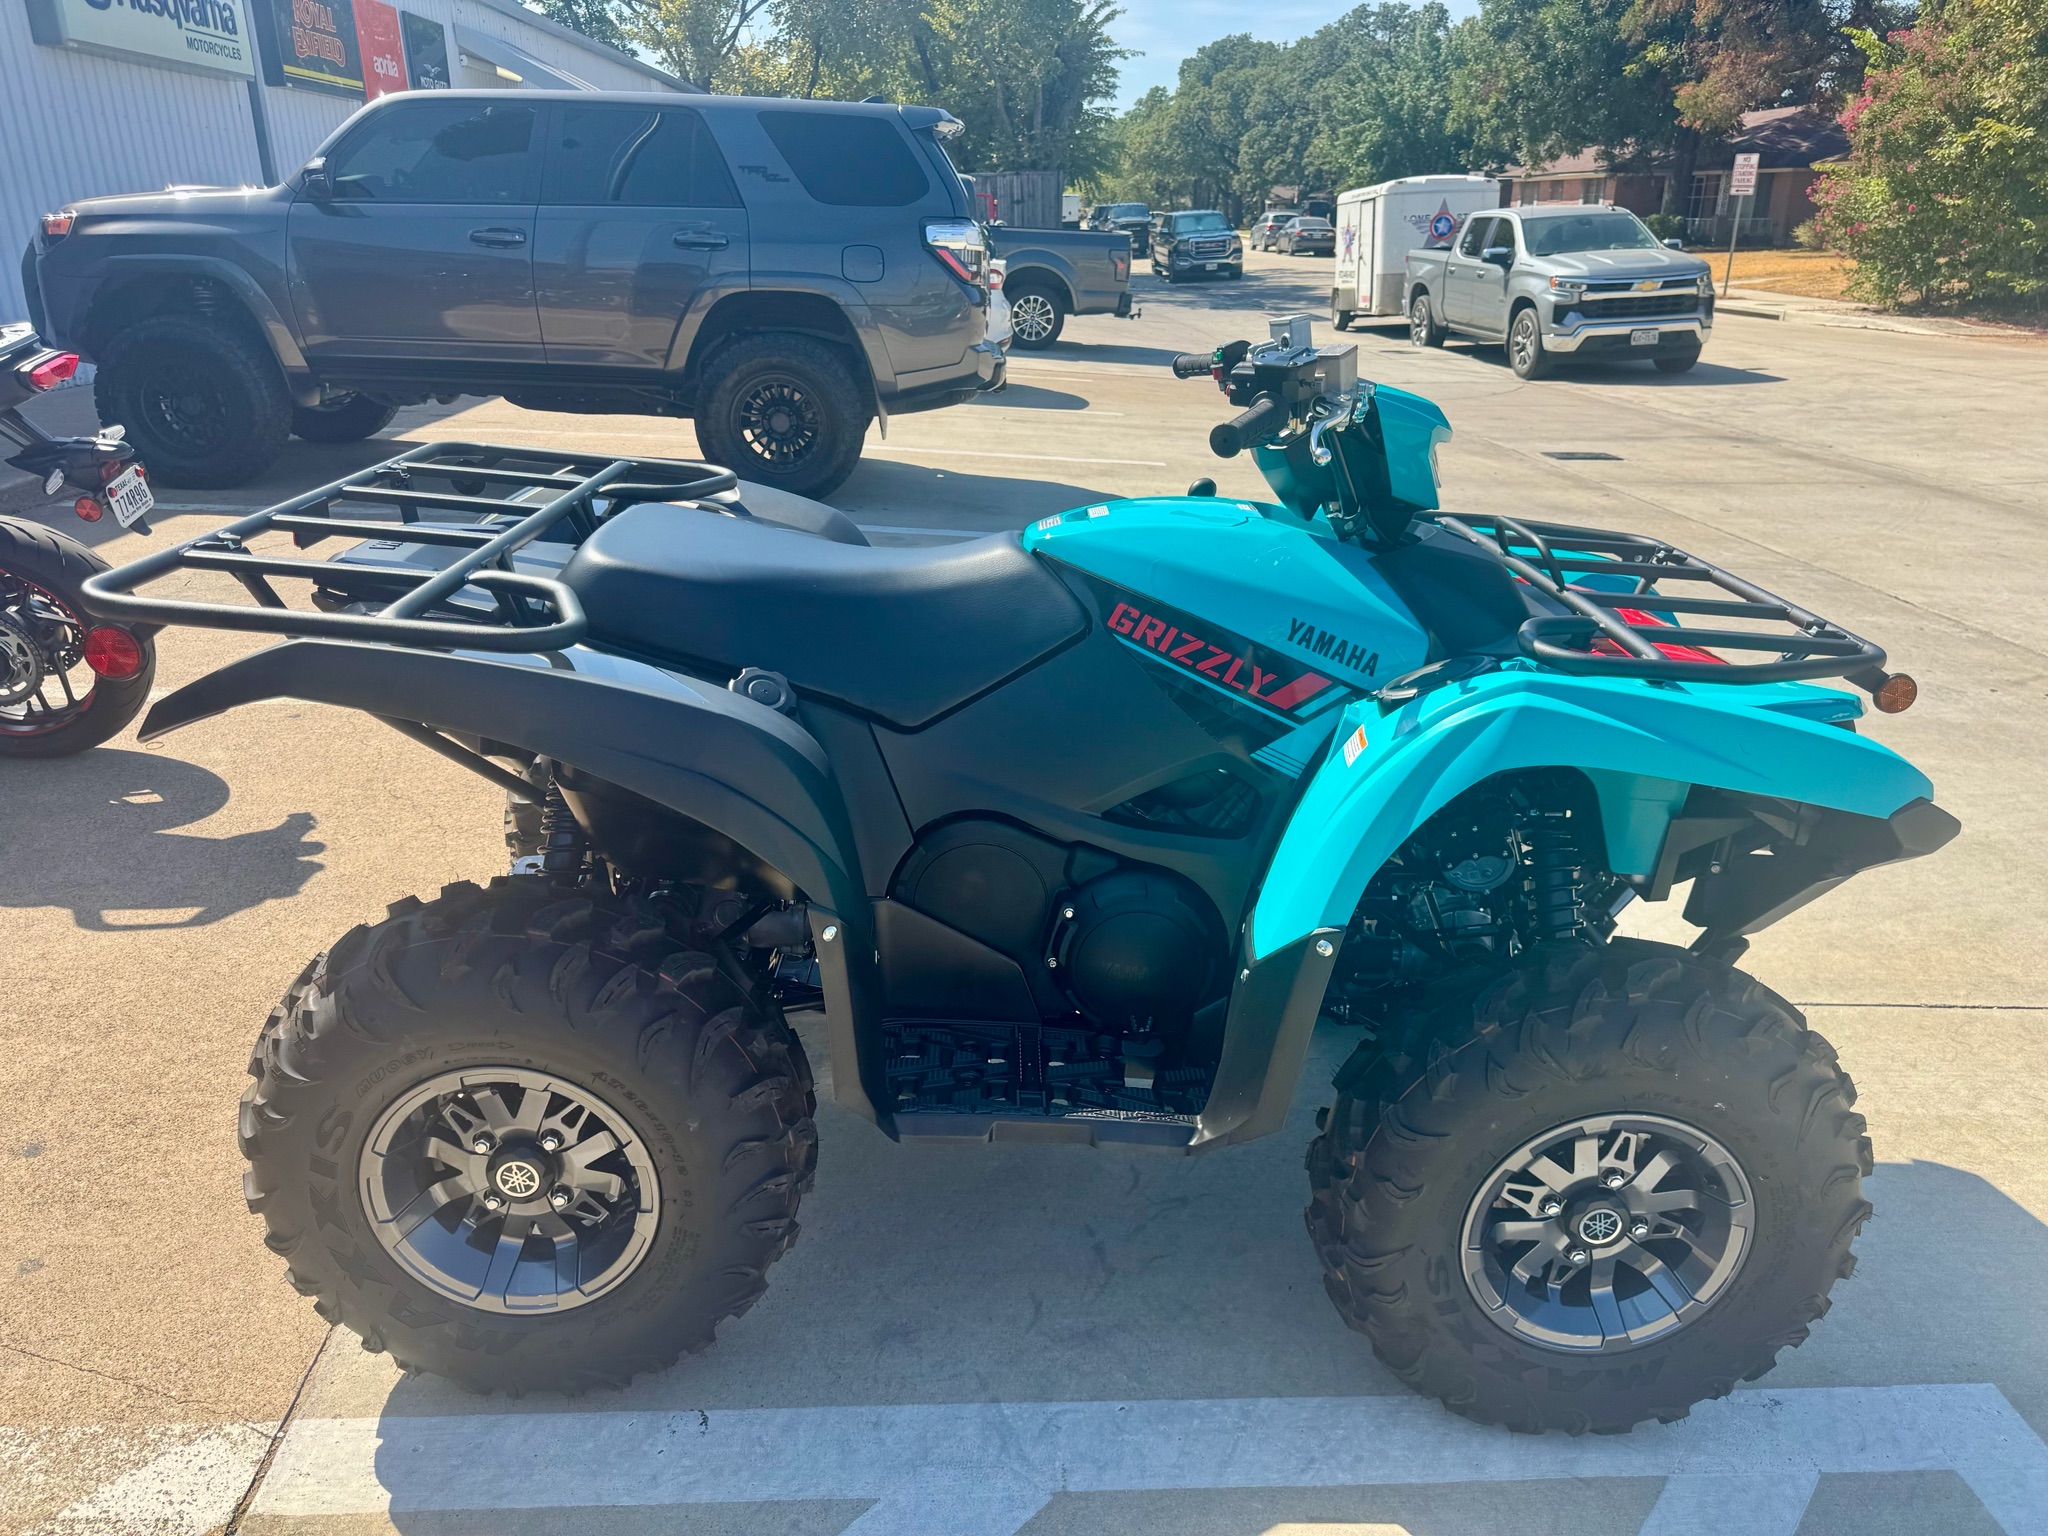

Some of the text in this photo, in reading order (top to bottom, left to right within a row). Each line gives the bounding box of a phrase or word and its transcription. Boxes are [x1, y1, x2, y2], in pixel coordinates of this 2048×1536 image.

[116, 0, 238, 36] usqvarna
[292, 0, 337, 33] ROYAL
[185, 36, 242, 61] MOTORCYCLES
[291, 26, 346, 68] ENFIELD
[373, 53, 400, 78] aprilia
[115, 481, 148, 517] 774R9G
[1106, 602, 1280, 699] GRIZZLY
[1286, 616, 1381, 678] YAMAHA
